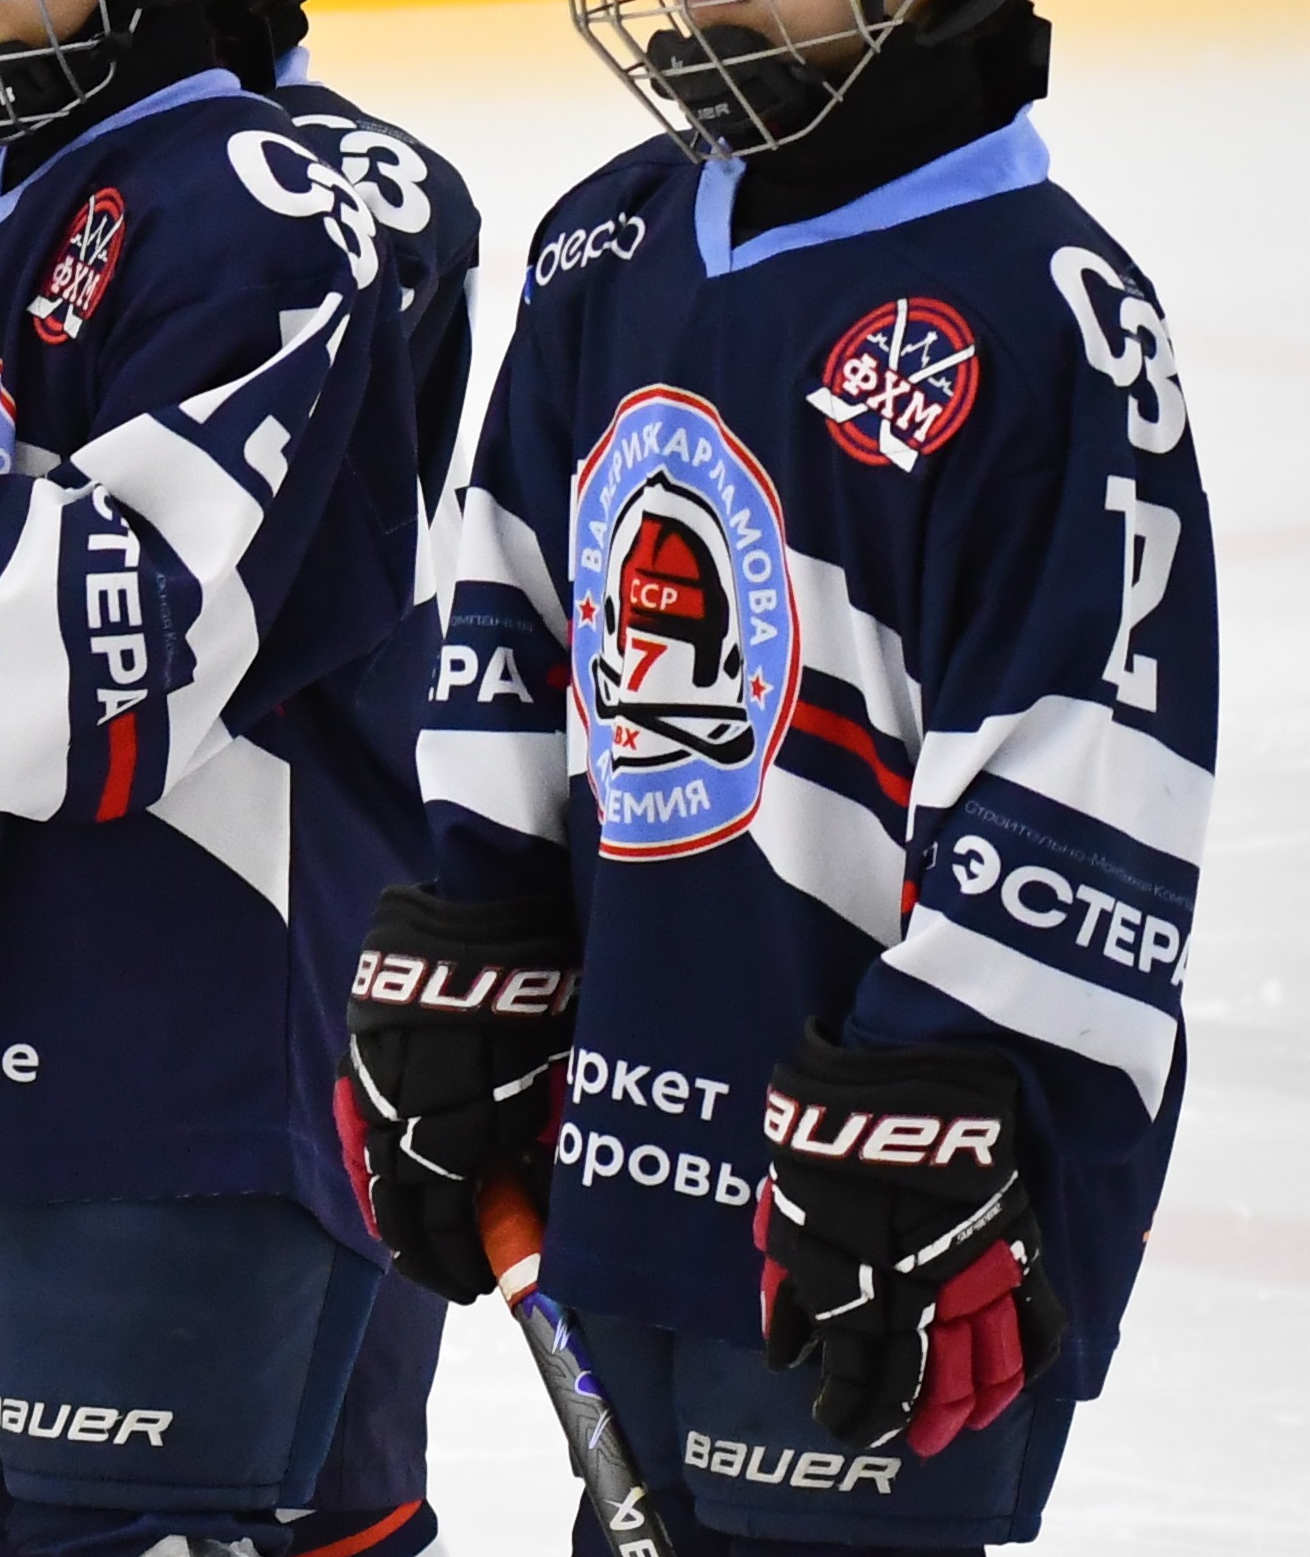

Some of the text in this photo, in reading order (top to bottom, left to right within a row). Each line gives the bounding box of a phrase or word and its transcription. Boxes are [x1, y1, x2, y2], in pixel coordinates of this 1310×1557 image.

[50, 254, 101, 311] ФХМ
[841, 353, 944, 443] ФХМ
[684, 1430, 902, 1495] BAUER
